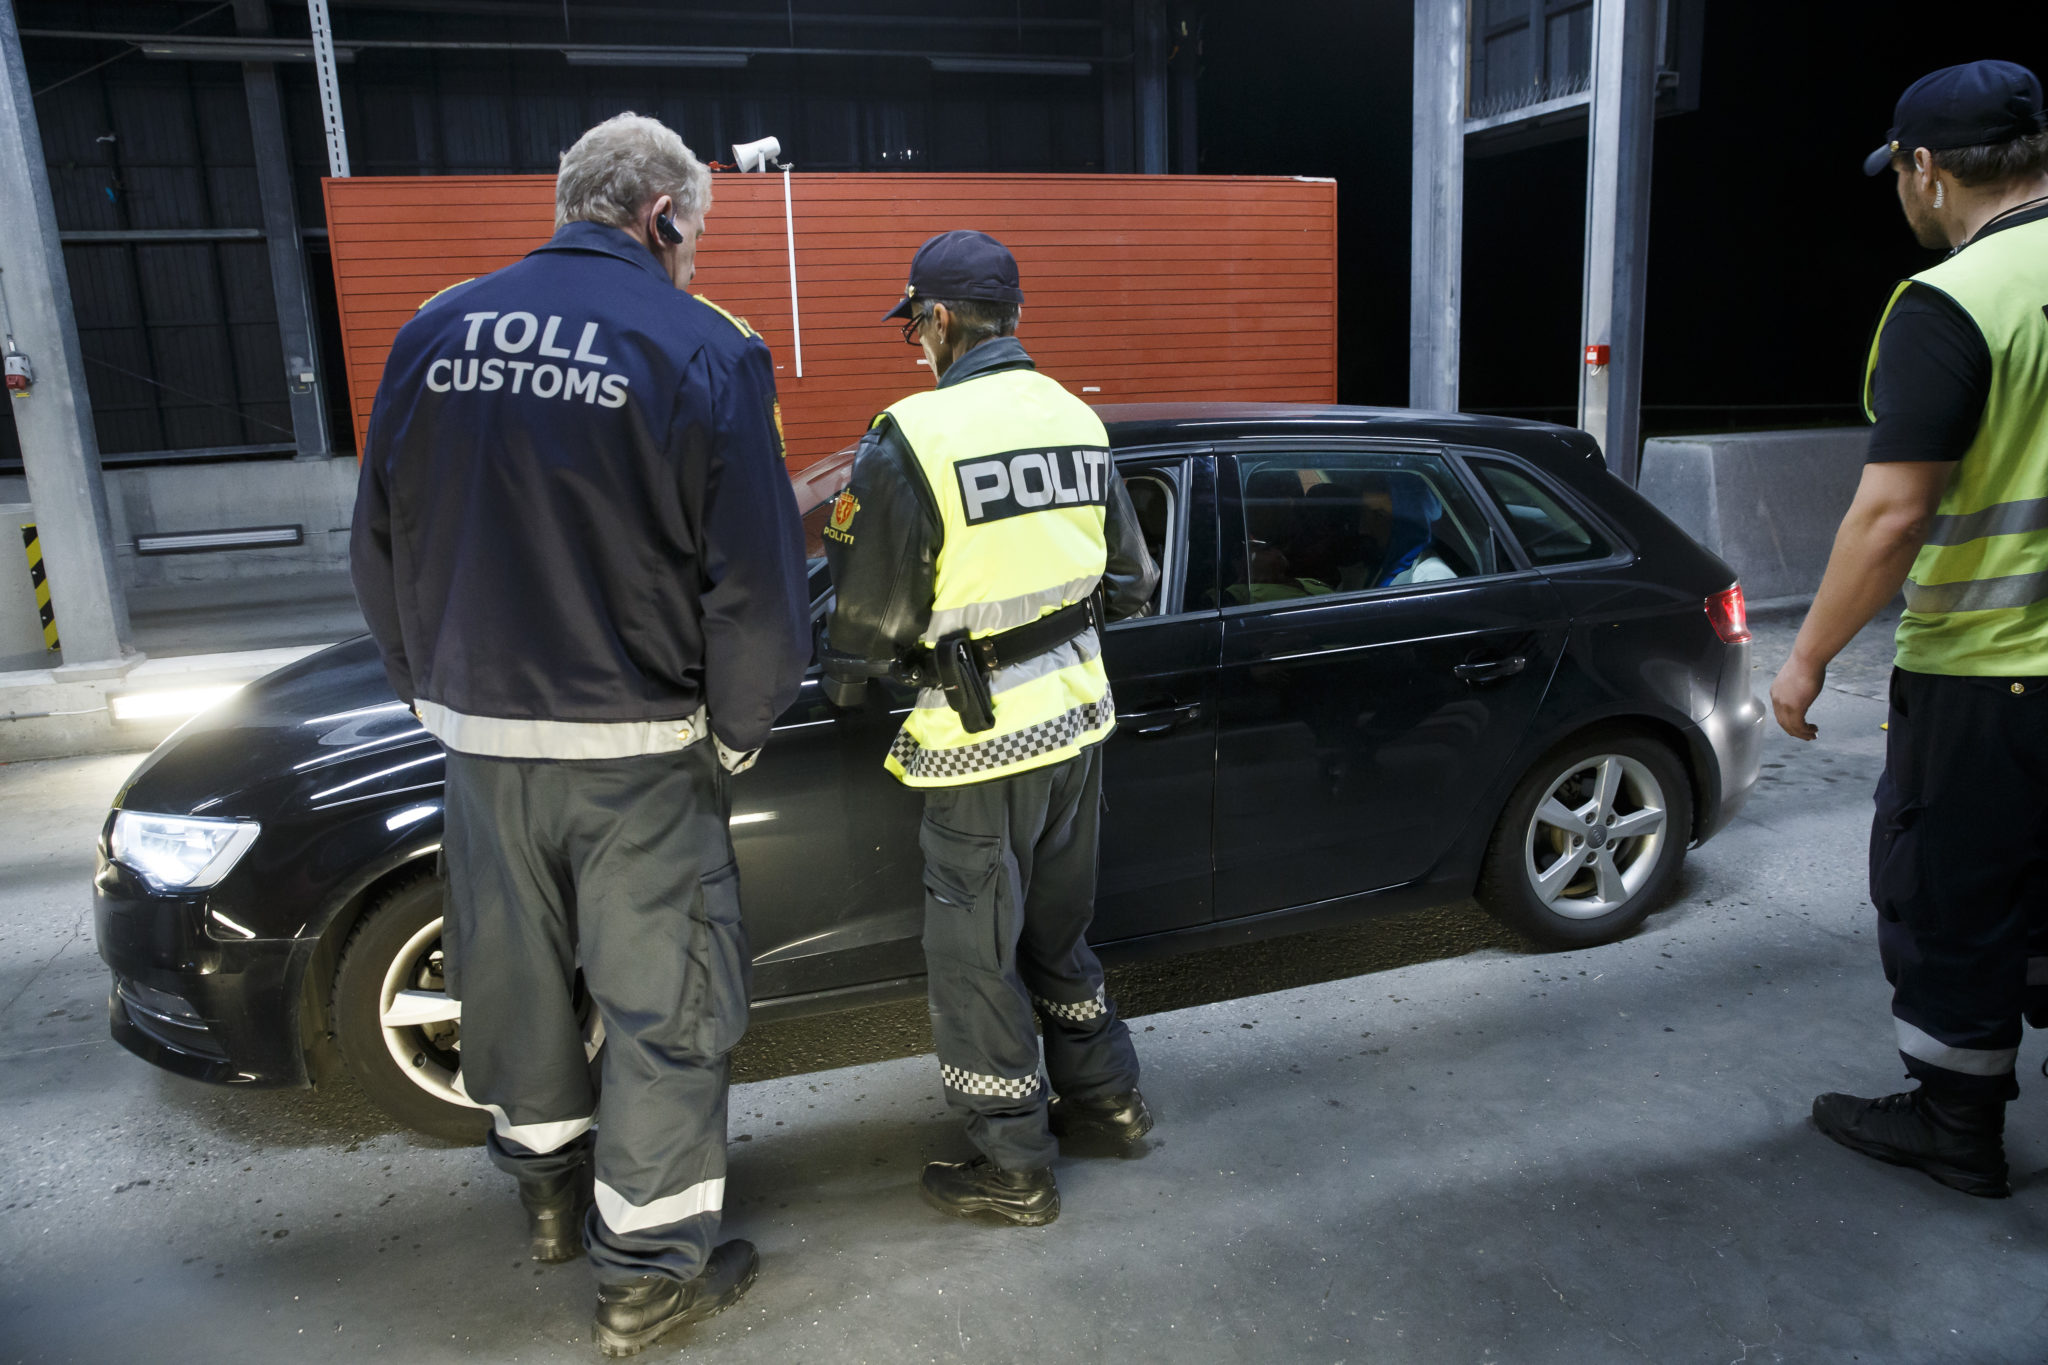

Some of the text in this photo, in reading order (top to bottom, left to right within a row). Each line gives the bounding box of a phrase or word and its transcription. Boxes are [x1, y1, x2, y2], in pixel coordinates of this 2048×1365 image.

[463, 311, 609, 365] TOLL
[426, 358, 630, 408] CUSTOMS
[823, 526, 855, 545] POLITI
